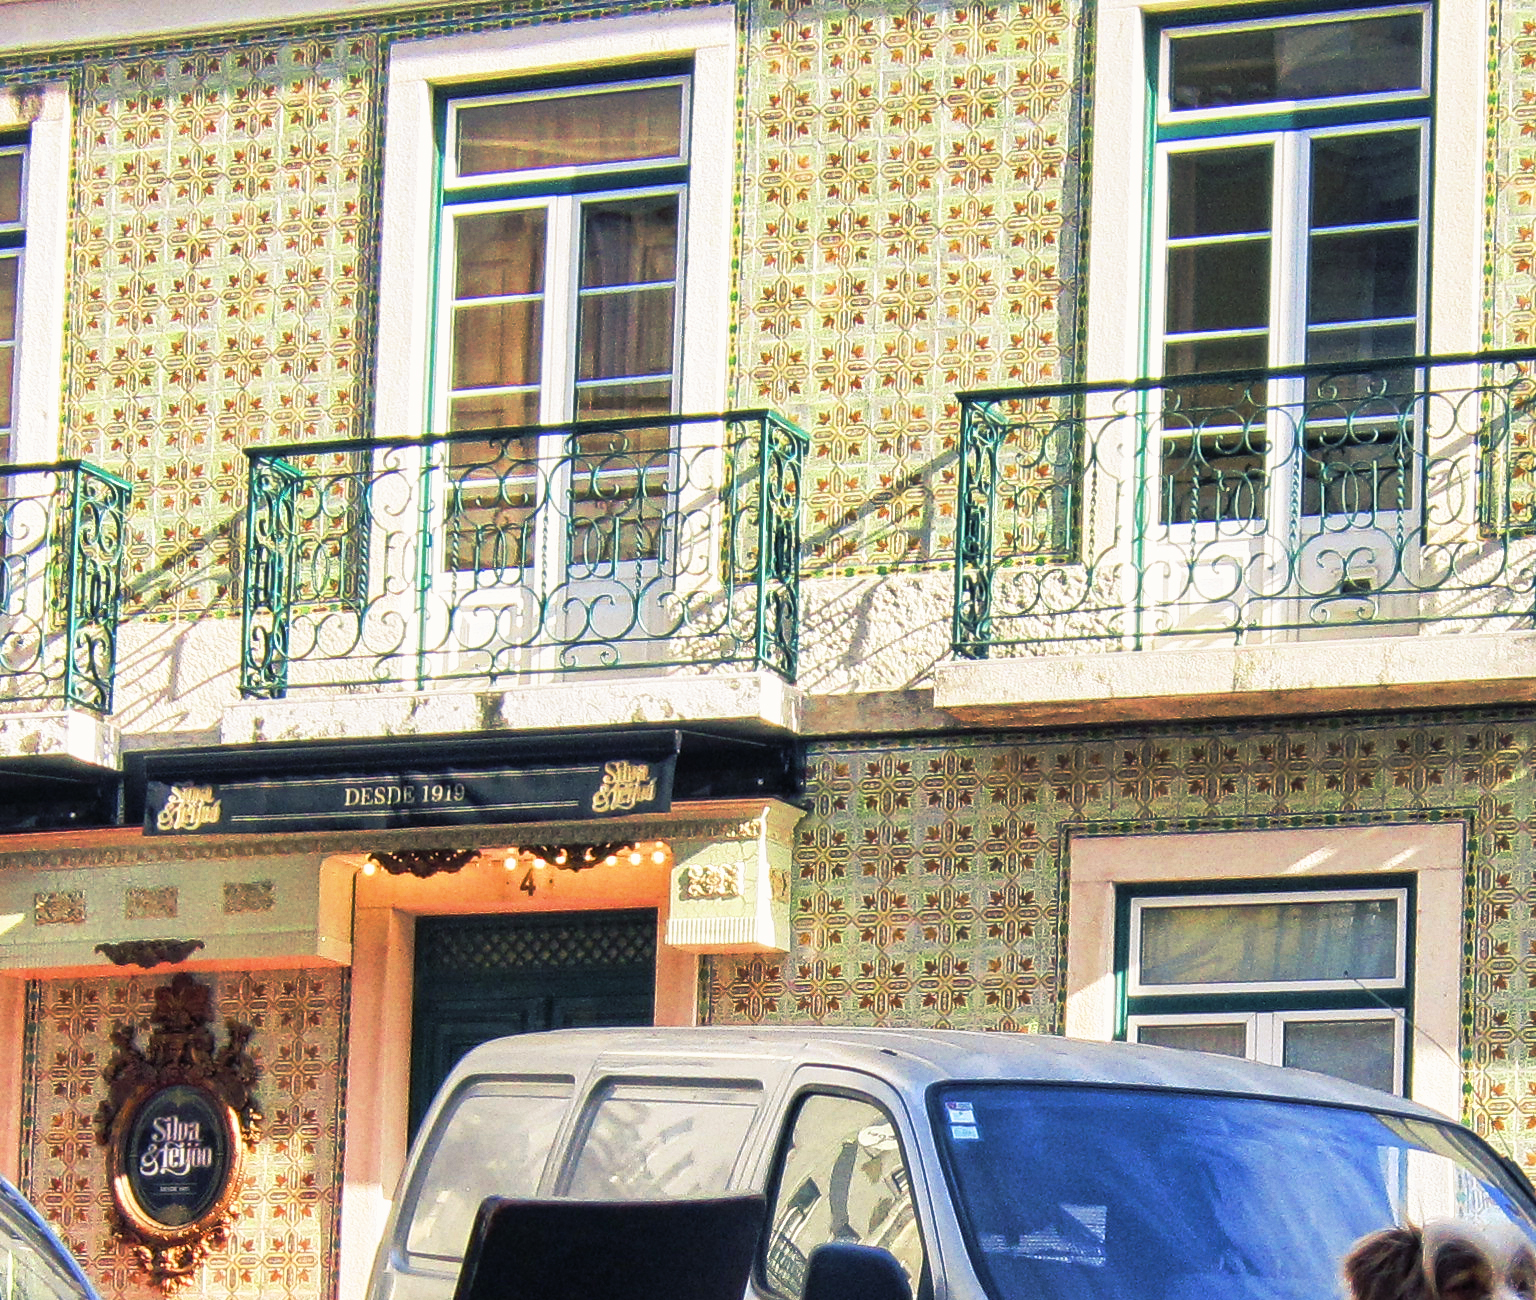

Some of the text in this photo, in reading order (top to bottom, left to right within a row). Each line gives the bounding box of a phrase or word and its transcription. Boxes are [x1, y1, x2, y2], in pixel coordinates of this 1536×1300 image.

[344, 783, 465, 807] DESDE 1919
[520, 868, 537, 896] 4
[152, 1115, 201, 1142] Silva
